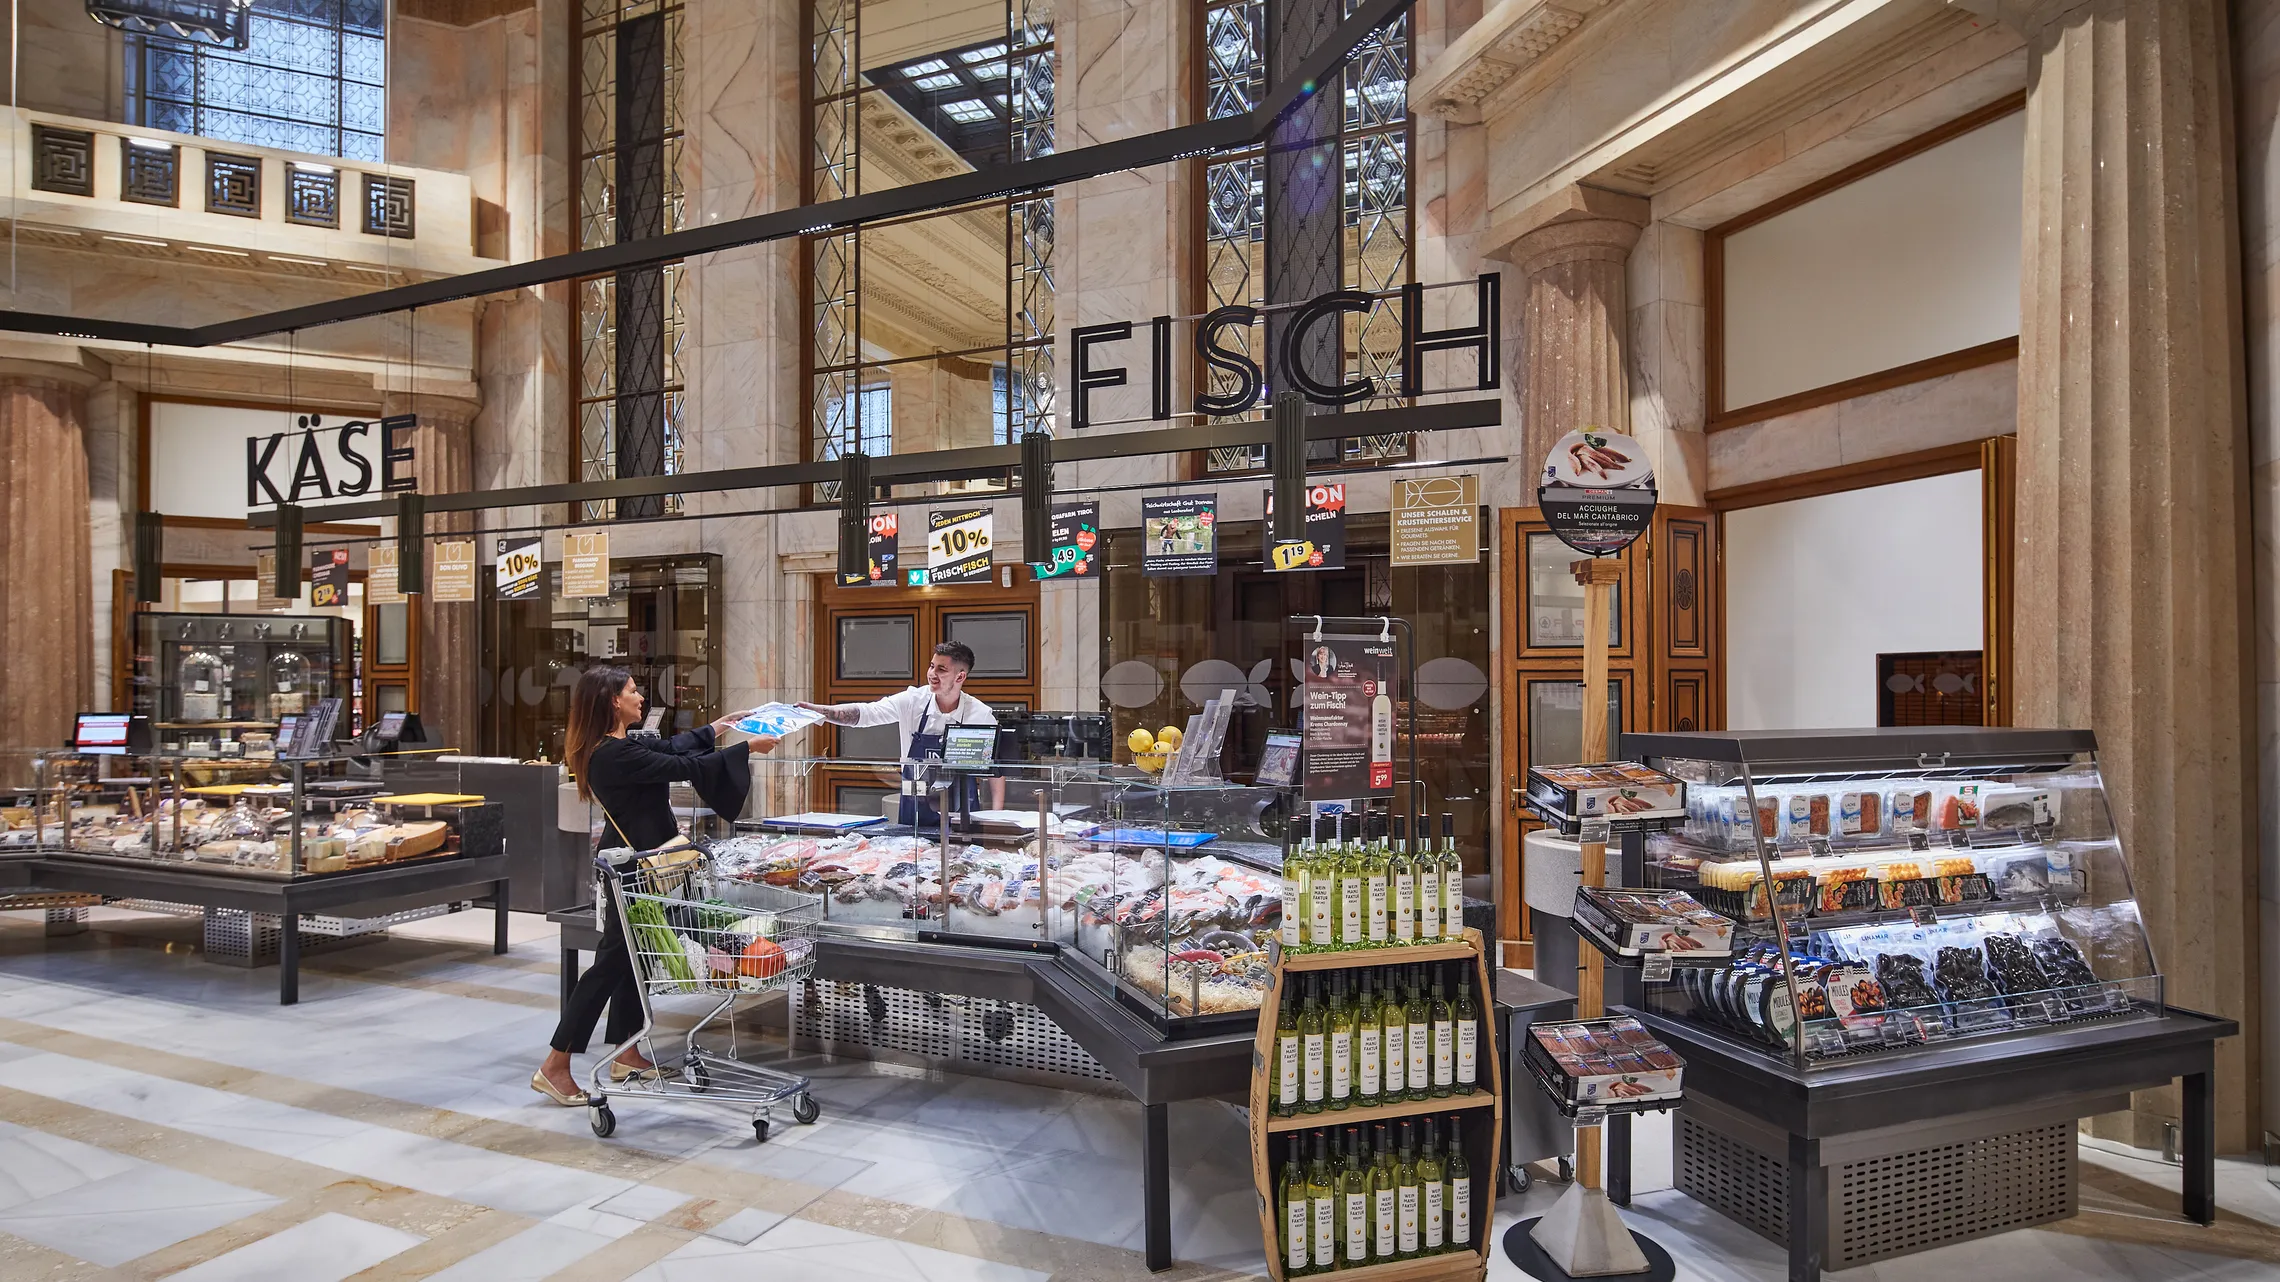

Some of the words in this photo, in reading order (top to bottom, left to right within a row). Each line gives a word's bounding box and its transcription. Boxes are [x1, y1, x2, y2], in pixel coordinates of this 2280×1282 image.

[1071, 272, 1501, 428] FISCH
[247, 413, 418, 506] KÄSE
[1077, 508, 1093, 516] TIROL
[1401, 511, 1425, 519] UNSER
[1591, 513, 1639, 521] CANTABRICO
[935, 519, 951, 528] JEDEN
[952, 511, 981, 523] MITTWOCH
[1397, 516, 1472, 526] KRUSTENTIERSERVICE
[1052, 528, 1069, 537] ELEN
[931, 529, 988, 557] -10%
[499, 554, 538, 577] -10%
[931, 557, 989, 581] FRISCHFISCH
[1363, 646, 1392, 655] weinwelt
[1310, 691, 1347, 702] Wein-Tipp
[1326, 701, 1346, 710] Fisch!
[1831, 985, 1849, 997] MOULES
